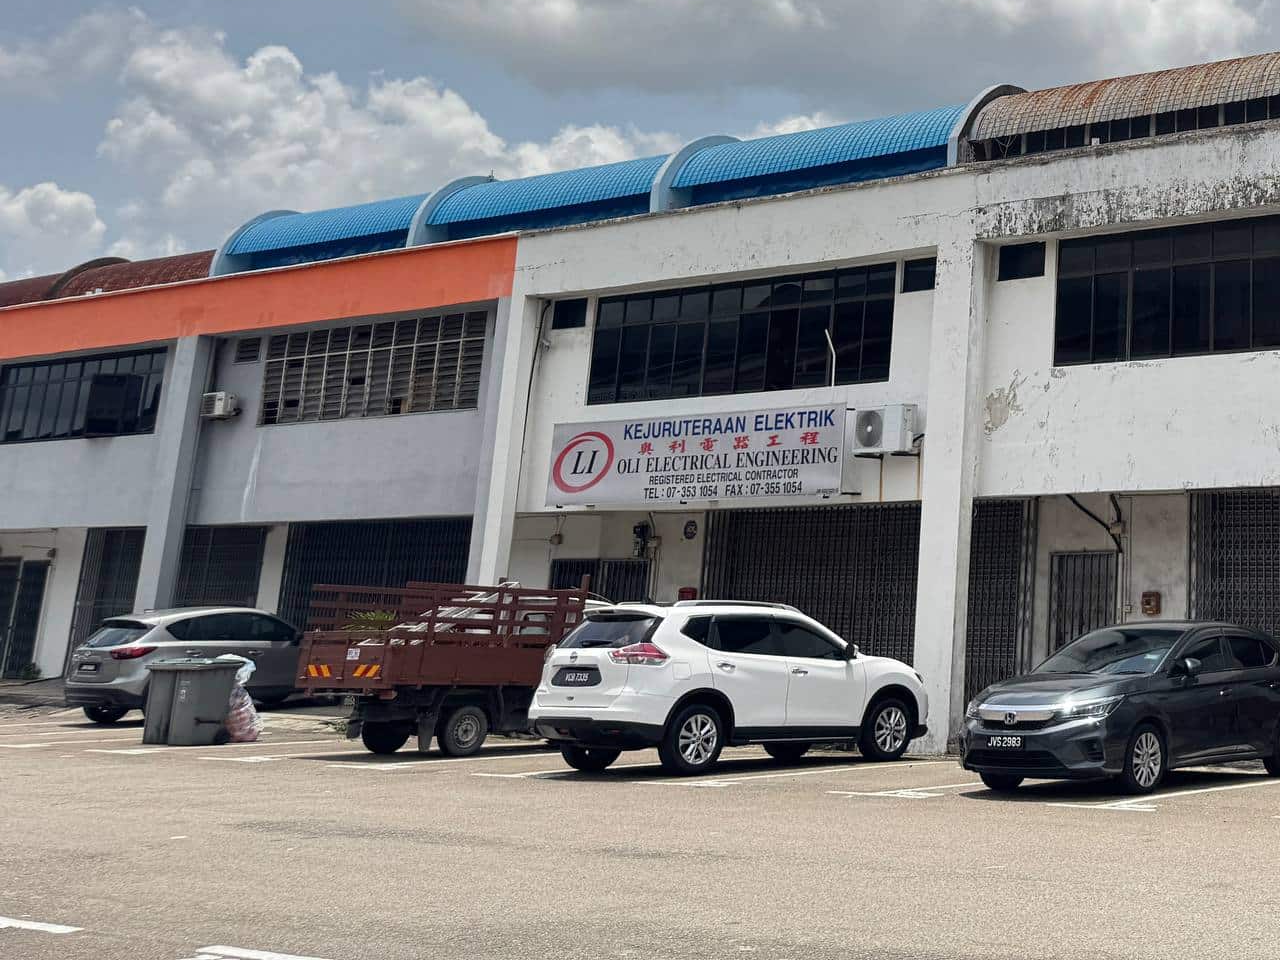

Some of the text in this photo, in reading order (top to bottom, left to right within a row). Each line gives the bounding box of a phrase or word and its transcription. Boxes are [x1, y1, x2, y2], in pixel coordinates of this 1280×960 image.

[623, 409, 835, 440] KEJURUTERAAN ELEKTRIK
[571, 449, 600, 475] LI
[617, 446, 838, 474] OLI ELECTRICAL ENGINEERING
[649, 468, 799, 486] REGISTERED ELECTRICAL CONTRACTOR
[666, 486, 696, 498] 07-353
[699, 485, 718, 497] 1054
[750, 482, 780, 495] 07-355
[783, 481, 803, 494] 1054
[988, 736, 1021, 747] JVS 2983
